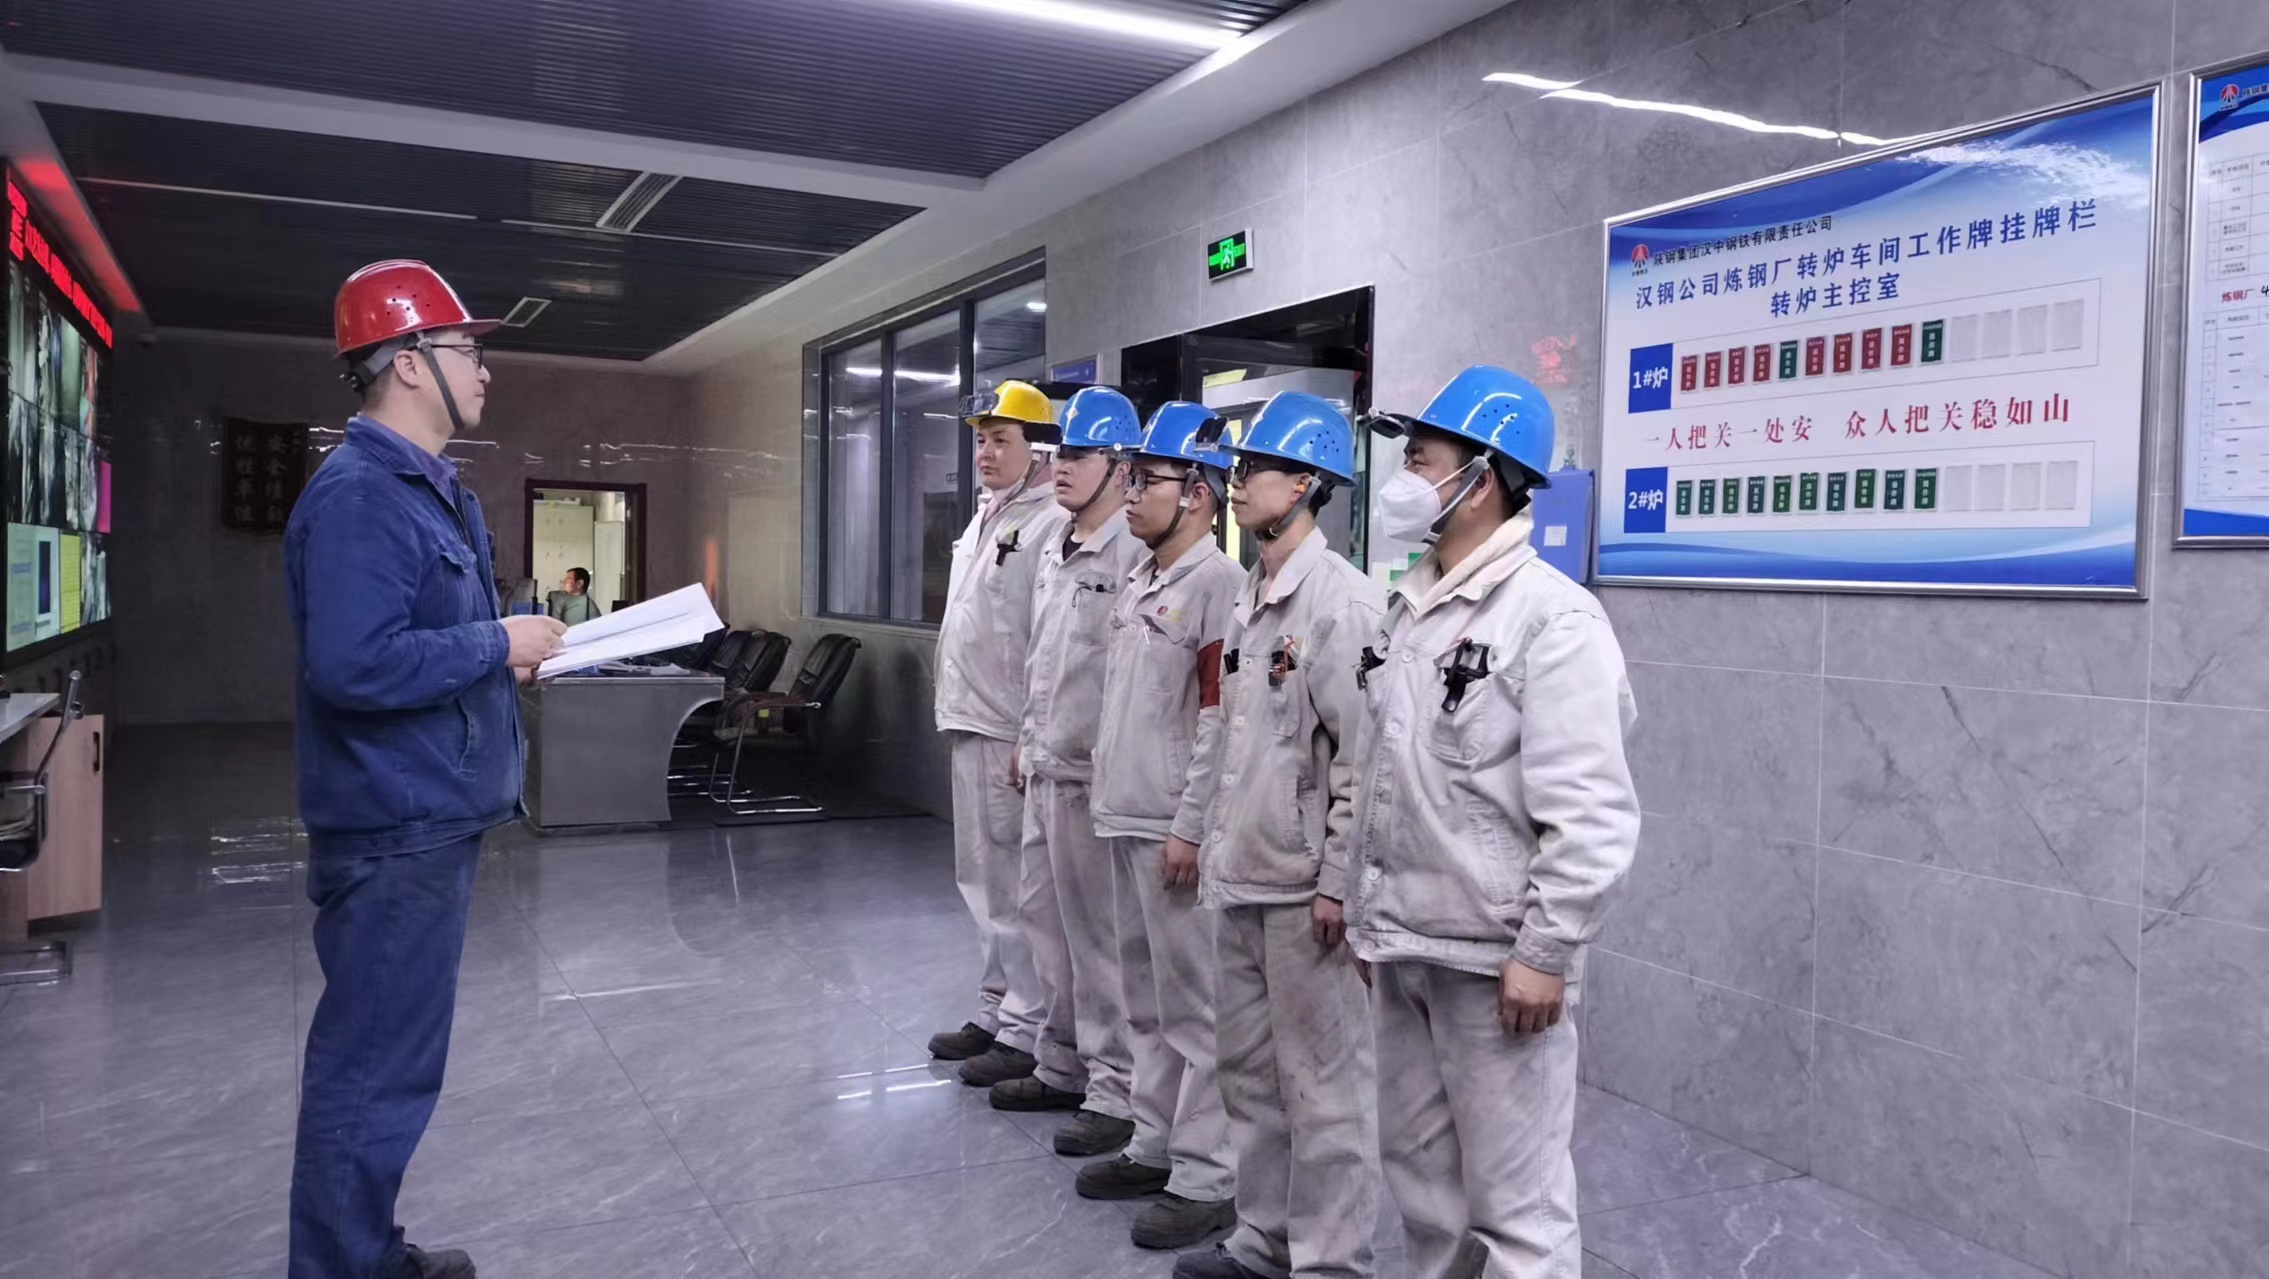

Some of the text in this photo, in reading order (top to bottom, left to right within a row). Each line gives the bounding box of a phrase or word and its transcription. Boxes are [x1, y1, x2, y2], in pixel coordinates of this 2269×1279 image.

[1636, 199, 2098, 309] 汉钢公司炼钢厂转炉车间工作牌挂牌栏
[1653, 215, 1833, 267] 陕钢集团汉中钢铁有限责任公司
[1771, 272, 1901, 318] 转炉主控室
[1632, 367, 1669, 390] 1#炉
[1645, 393, 2070, 451] 一人把关一处安 众人把关稳如山
[1629, 490, 1664, 511] 2#炉
